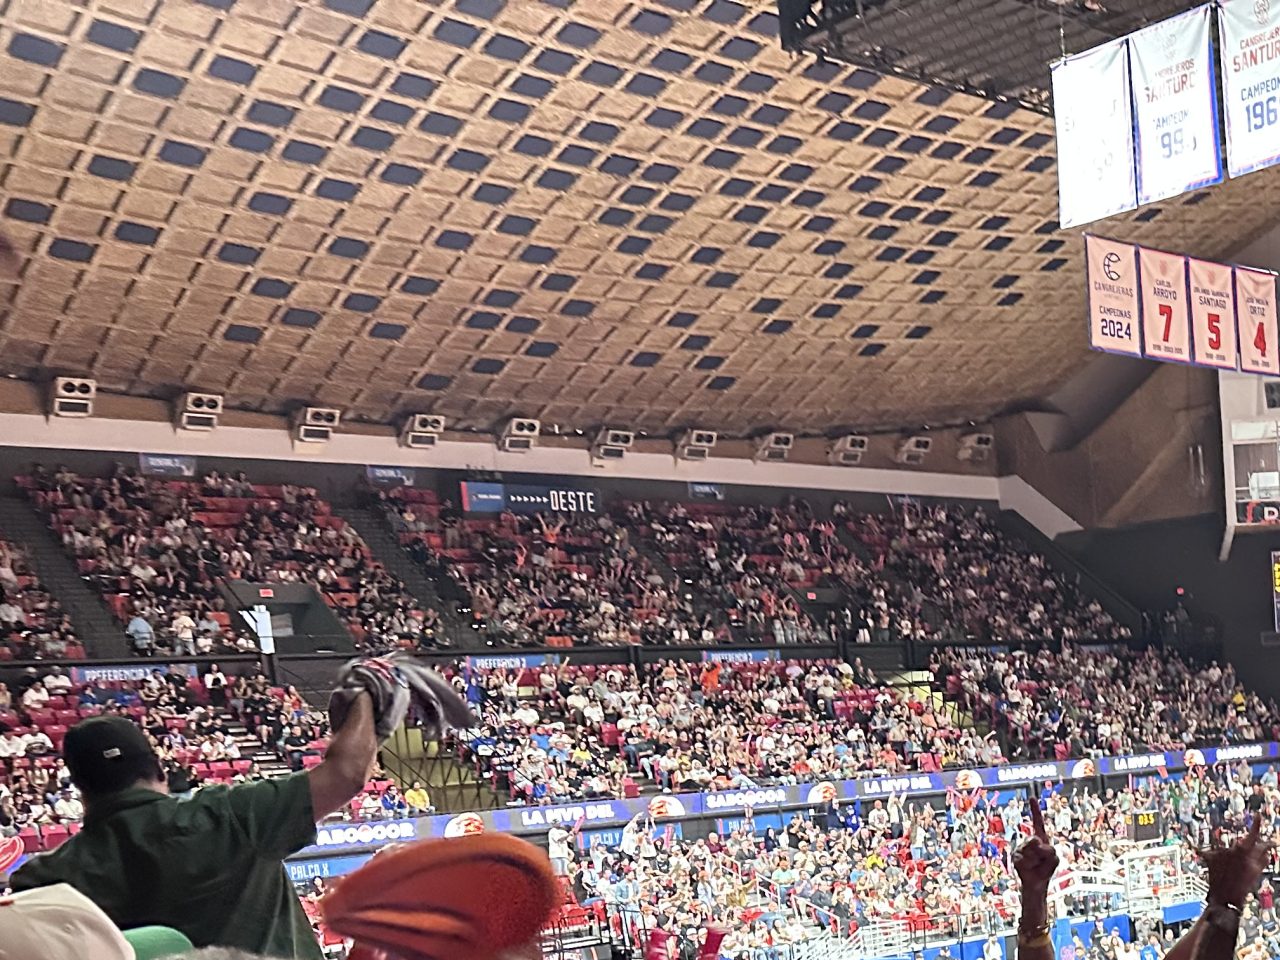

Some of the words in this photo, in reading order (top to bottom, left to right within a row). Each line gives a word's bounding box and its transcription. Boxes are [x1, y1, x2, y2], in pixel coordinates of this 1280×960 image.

[1153, 287, 1177, 300] ARROYO
[1199, 296, 1227, 310] SANTIAGO
[1099, 305, 1132, 319] CAMPEONAS
[1158, 303, 1173, 342] 7
[1101, 318, 1132, 340] 2024
[1207, 312, 1221, 350] 5
[1253, 321, 1267, 357] 4
[550, 489, 596, 513] OESTE
[1114, 758, 1127, 770] LA
[863, 780, 880, 793] LA
[521, 810, 545, 826] LA
[546, 807, 584, 823] MVP
[585, 804, 615, 820] DEL
[316, 822, 415, 846] ABOOOOR
[290, 862, 321, 880] PALCO
[322, 862, 330, 877] X
